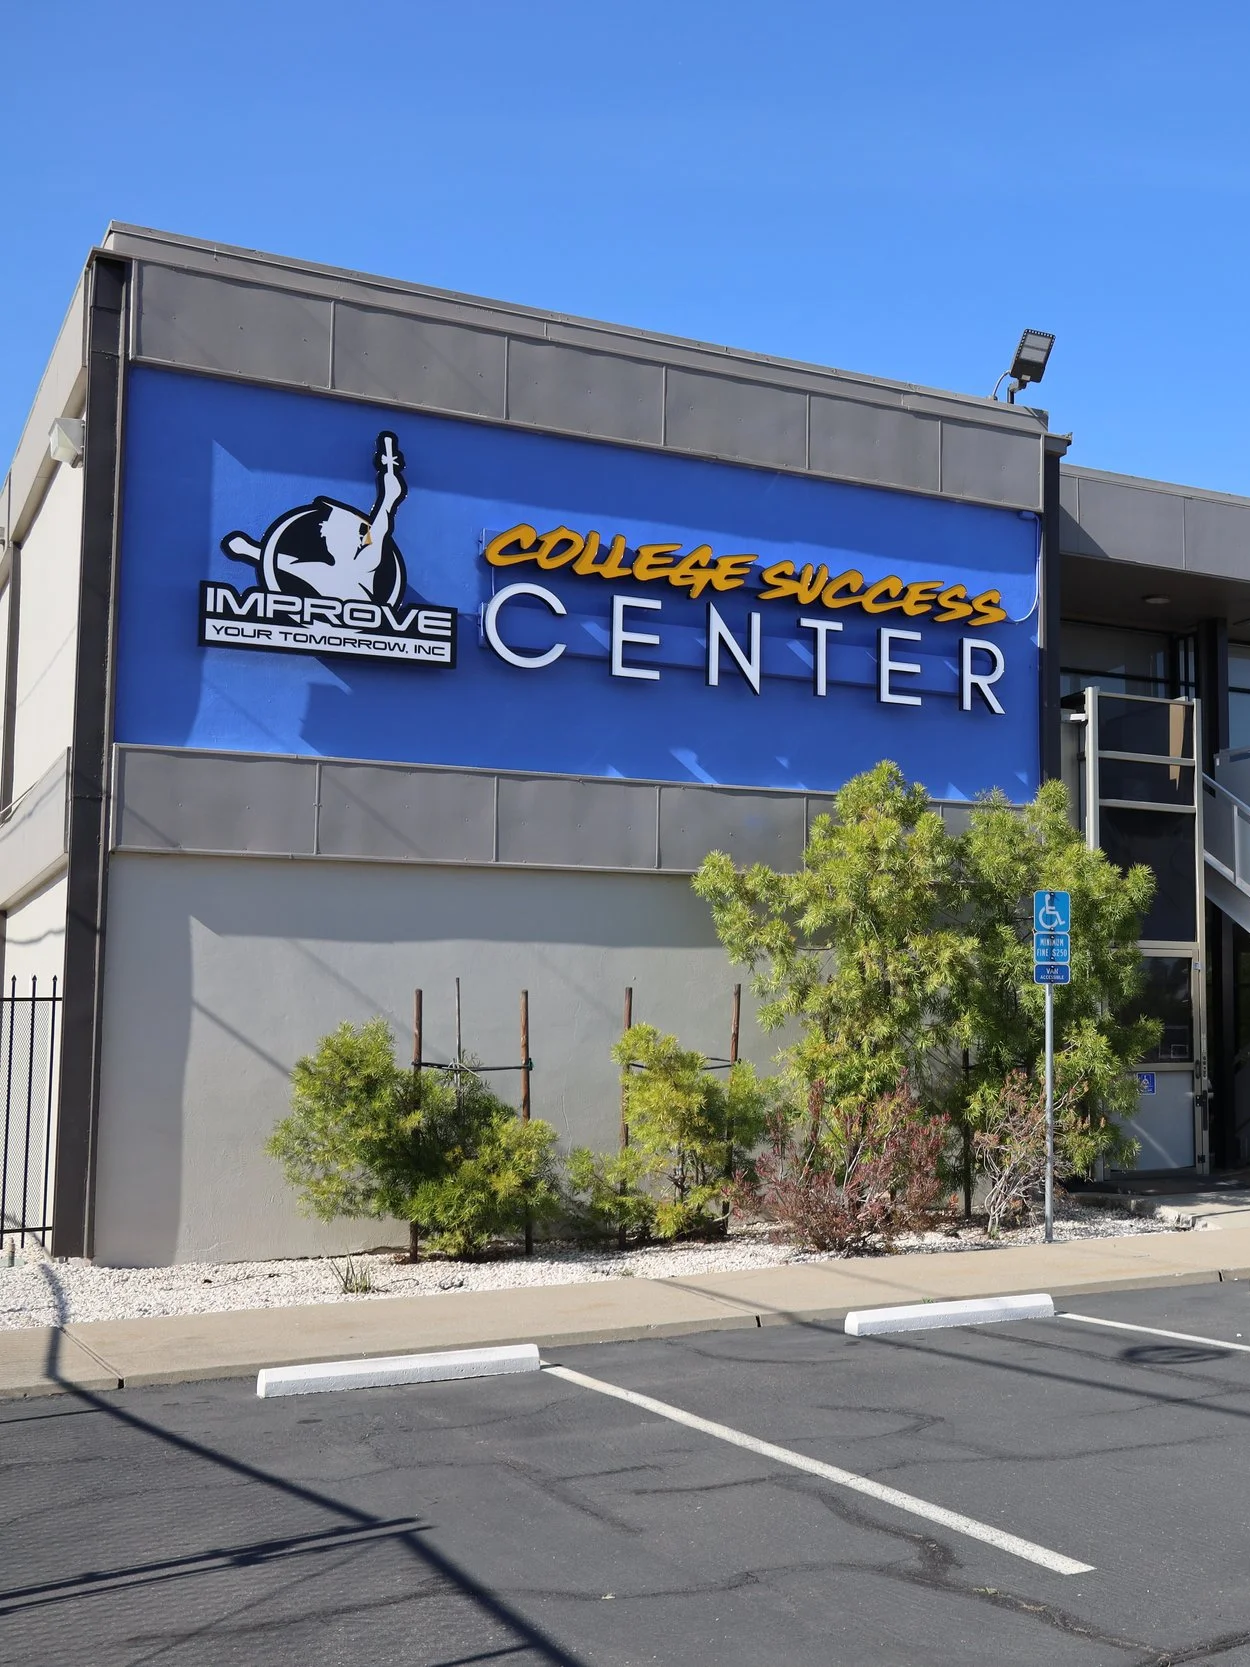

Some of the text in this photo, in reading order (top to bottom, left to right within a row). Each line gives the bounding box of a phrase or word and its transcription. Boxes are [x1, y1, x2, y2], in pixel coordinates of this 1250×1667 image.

[484, 523, 1008, 626] COLLEGE SUCCESS
[205, 587, 452, 636] IMPROVE
[212, 624, 446, 657] YOUR TOMORROW, INC
[484, 582, 1006, 715] CENTER
[1036, 948, 1068, 957] FINE $250
